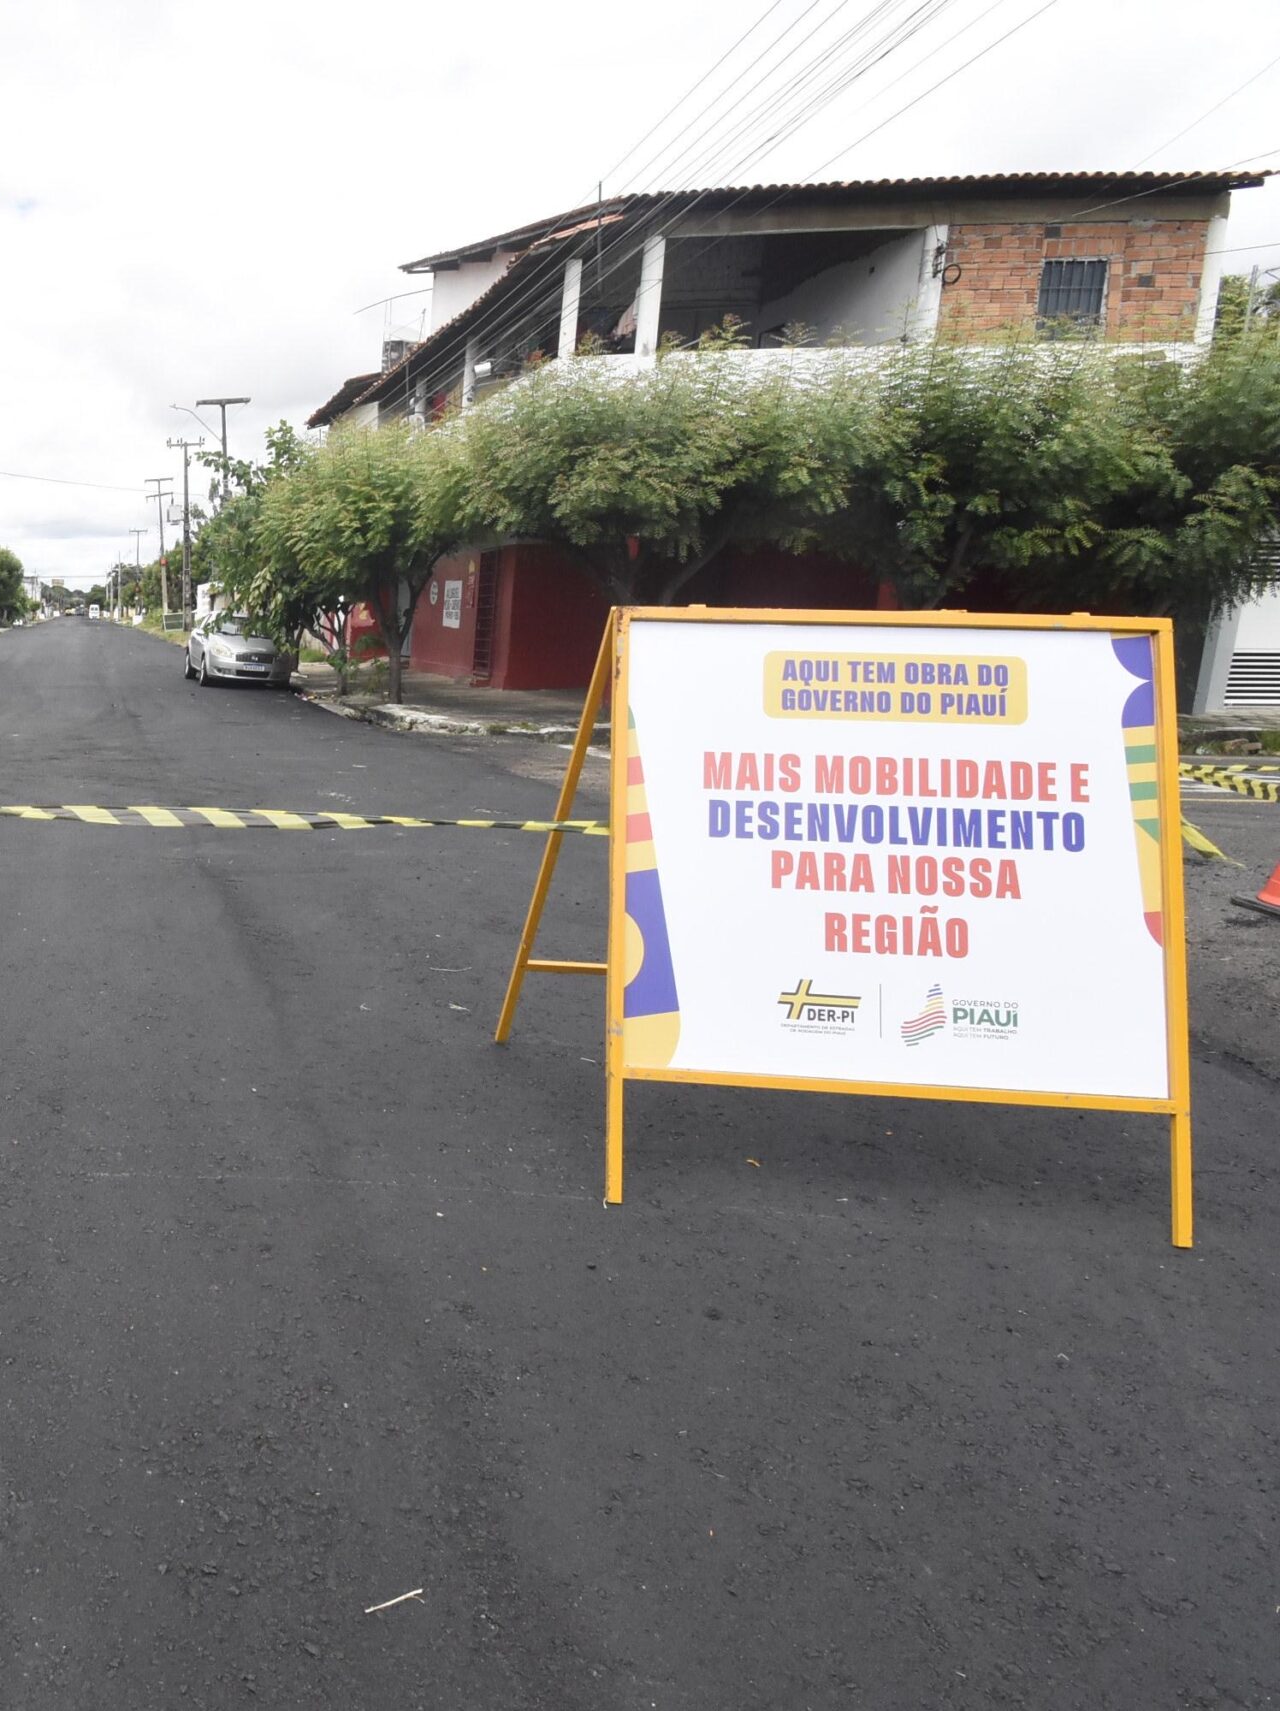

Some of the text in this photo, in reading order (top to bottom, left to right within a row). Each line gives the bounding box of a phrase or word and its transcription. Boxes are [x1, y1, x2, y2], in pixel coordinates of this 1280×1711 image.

[782, 660, 1008, 687] AQUI TEM OBRA DO
[782, 689, 1007, 716] GOVERNO DO PIAUÍ
[703, 751, 1090, 802] MAIS MOBILIDADE E
[708, 800, 1085, 852] DESENVOLVIMENTO
[771, 850, 1022, 900] PARA NOSSA
[824, 905, 968, 959] REGIÃO
[807, 1009, 855, 1023] DER-PI
[952, 999, 1000, 1008] GOVERNO
